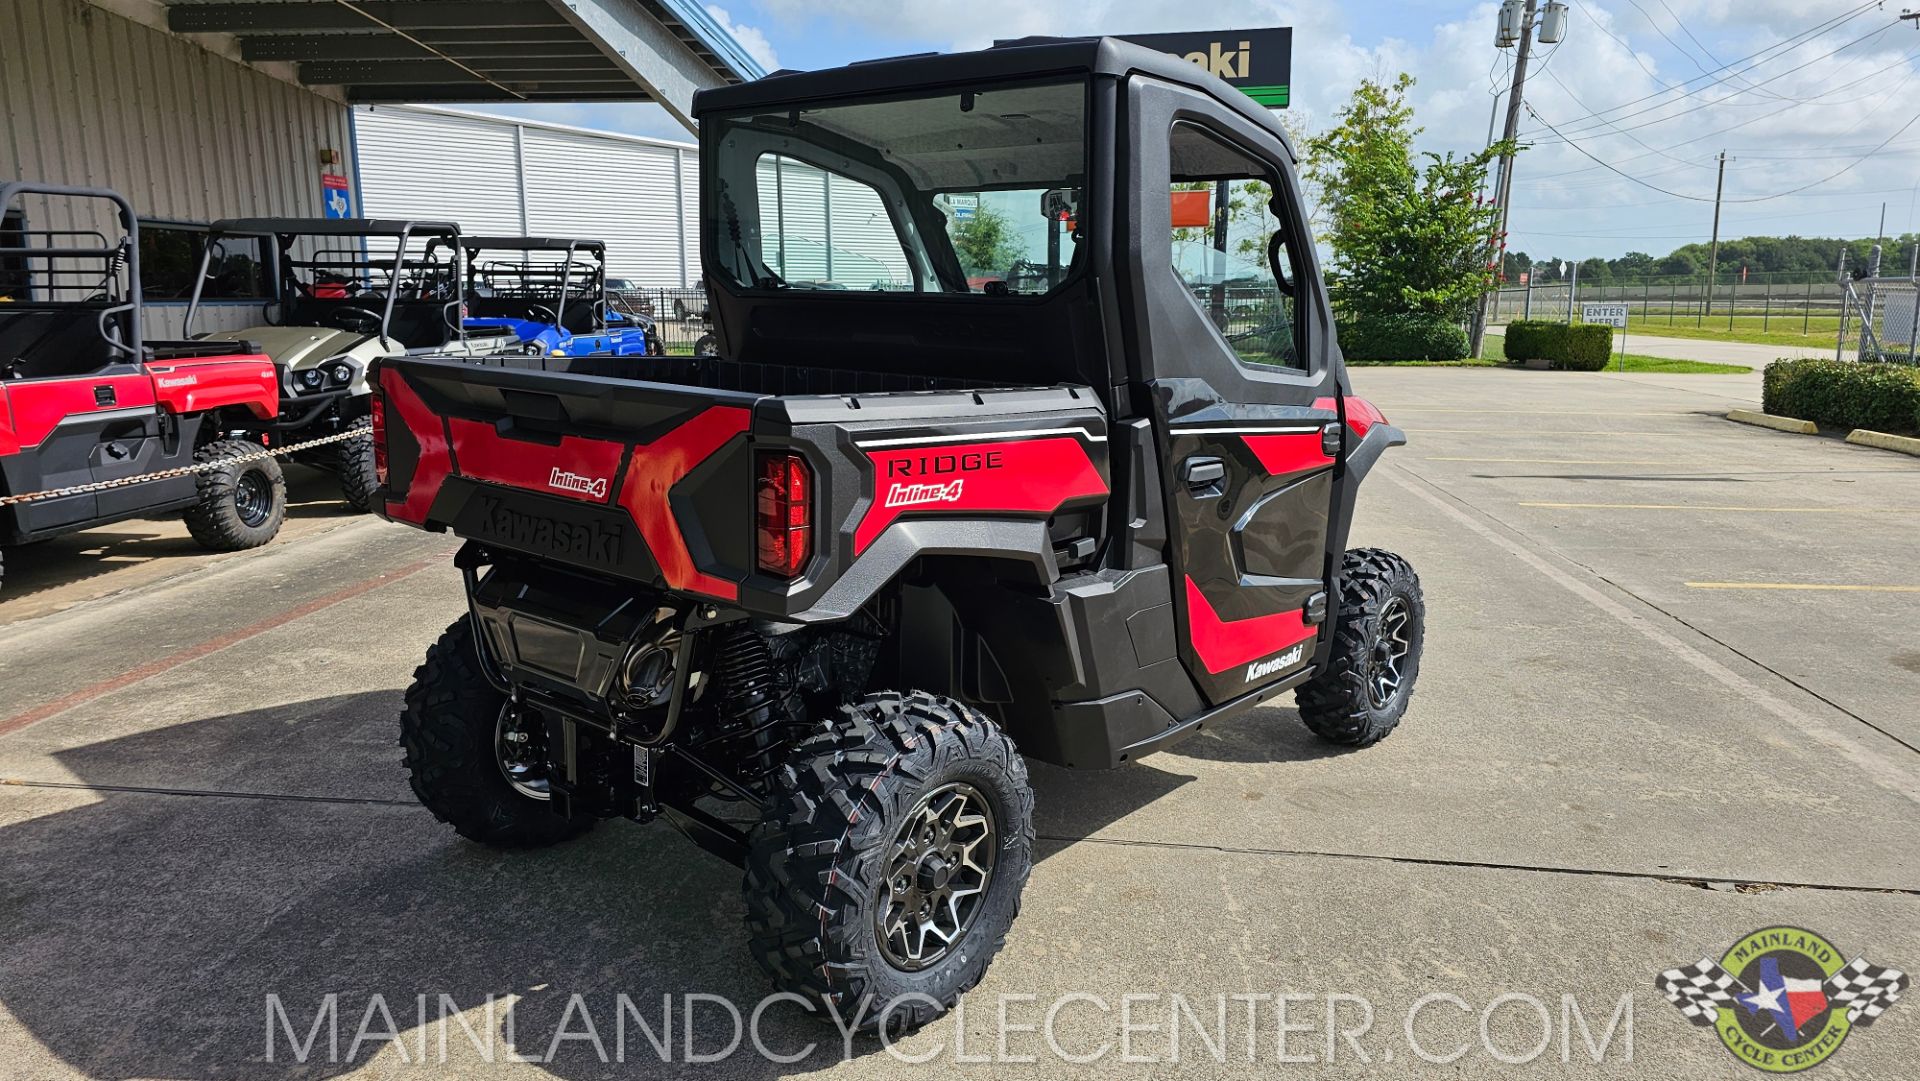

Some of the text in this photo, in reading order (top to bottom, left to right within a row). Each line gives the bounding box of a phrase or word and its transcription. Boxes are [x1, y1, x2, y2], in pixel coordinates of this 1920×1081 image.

[1586, 308, 1624, 317] ENTER
[157, 374, 198, 388] Kawasaki
[888, 451, 1003, 478] RIDGE
[549, 467, 607, 498] Inline-4
[885, 479, 964, 508] Inline-4
[481, 494, 625, 567] Kawasaki
[1245, 644, 1304, 683] Kawasaki
